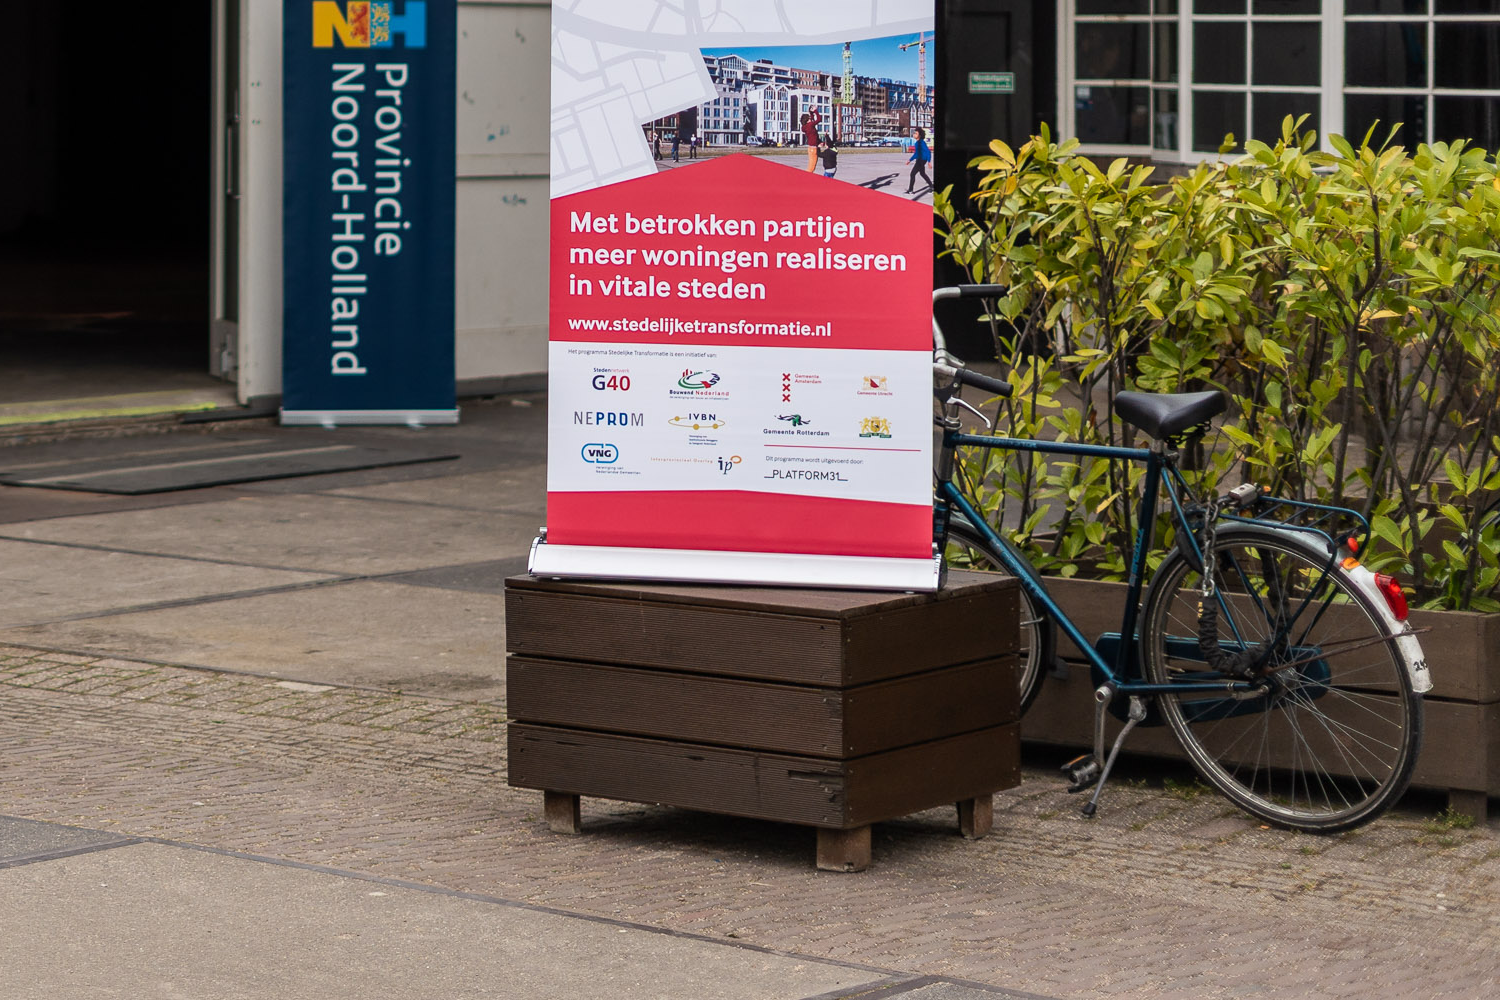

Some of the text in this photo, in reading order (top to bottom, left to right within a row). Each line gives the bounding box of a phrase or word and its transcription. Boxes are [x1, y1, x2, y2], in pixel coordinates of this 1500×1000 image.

[375, 63, 411, 256] Provincie
[331, 63, 368, 376] Noord-Holland
[569, 211, 865, 243] Met betrokken partijen
[569, 245, 906, 274] meer woningen realiseren
[569, 273, 766, 300] in vitale steden
[568, 317, 832, 337] www.stedelijketransformatie.nl
[592, 374, 631, 391] G40
[573, 411, 644, 427] NEPROM
[688, 413, 716, 421] IVBN
[588, 449, 612, 458] VNG
[821, 457, 849, 465] uitgevoerd
[771, 469, 841, 481] PLATFORM31
